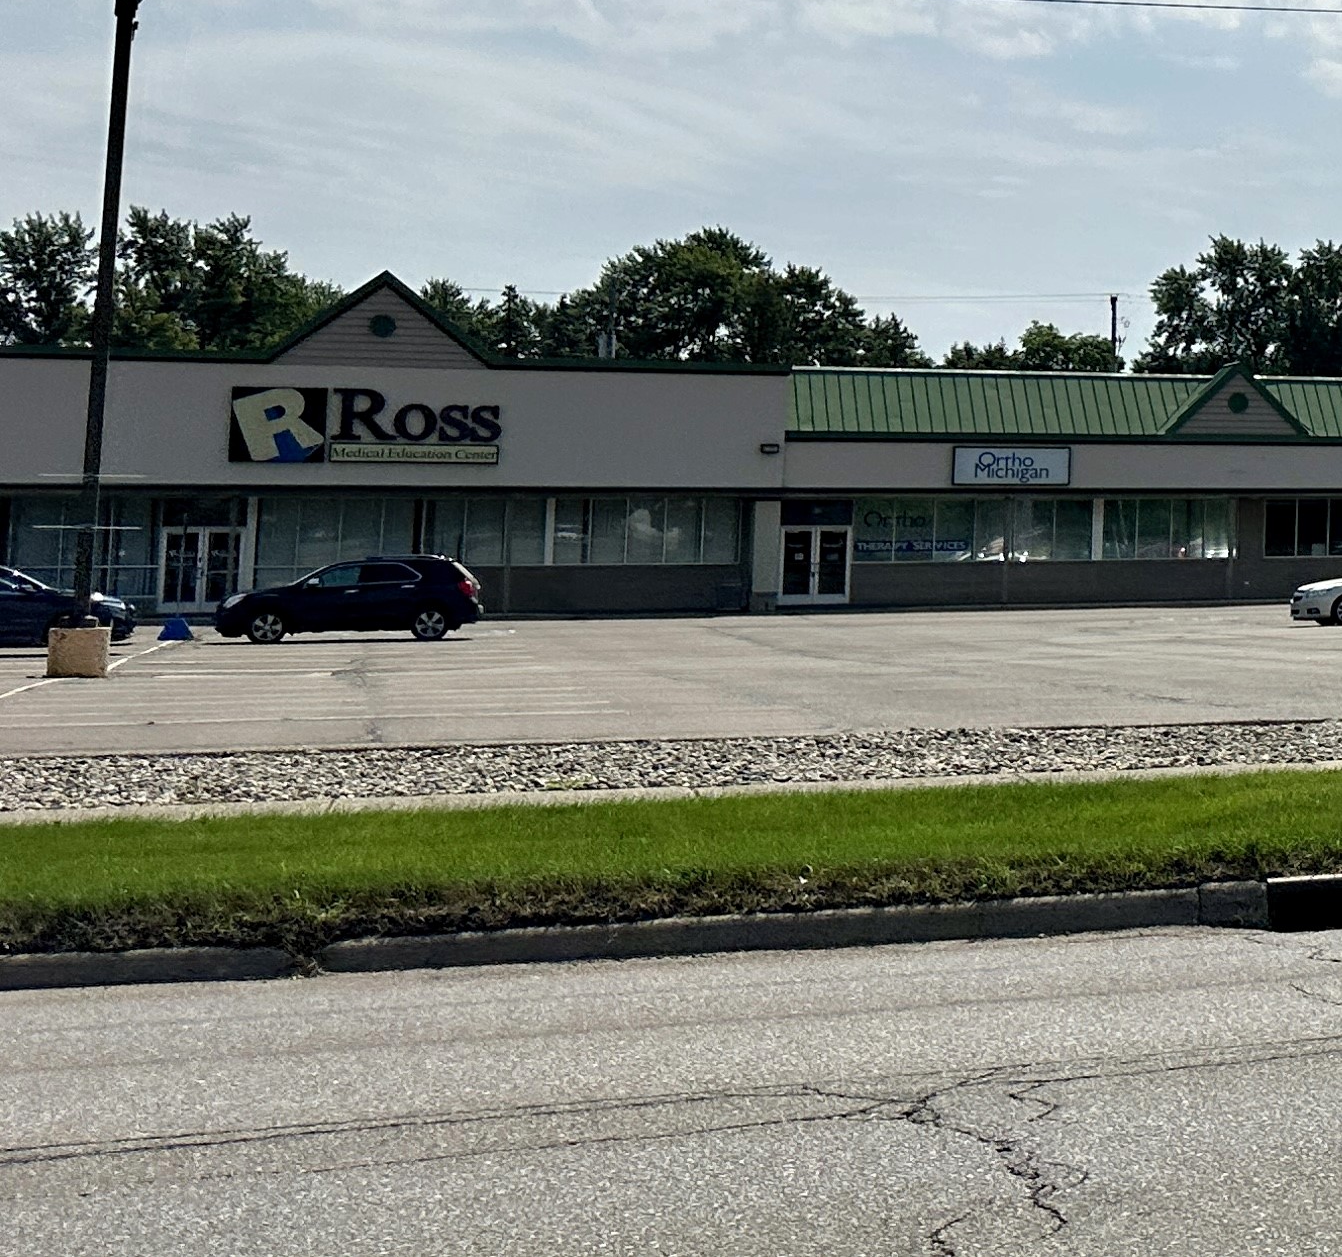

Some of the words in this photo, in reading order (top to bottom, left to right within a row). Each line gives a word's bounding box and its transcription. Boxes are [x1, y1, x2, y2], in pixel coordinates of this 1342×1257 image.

[332, 447, 384, 460] Medical
[388, 448, 452, 460] Education
[454, 449, 498, 461] Center
[978, 451, 1034, 468] Ortho
[975, 462, 1049, 483] Michigan
[863, 509, 927, 529] Ortho
[857, 541, 908, 551] THERAPY
[912, 540, 967, 551] SERVICES
